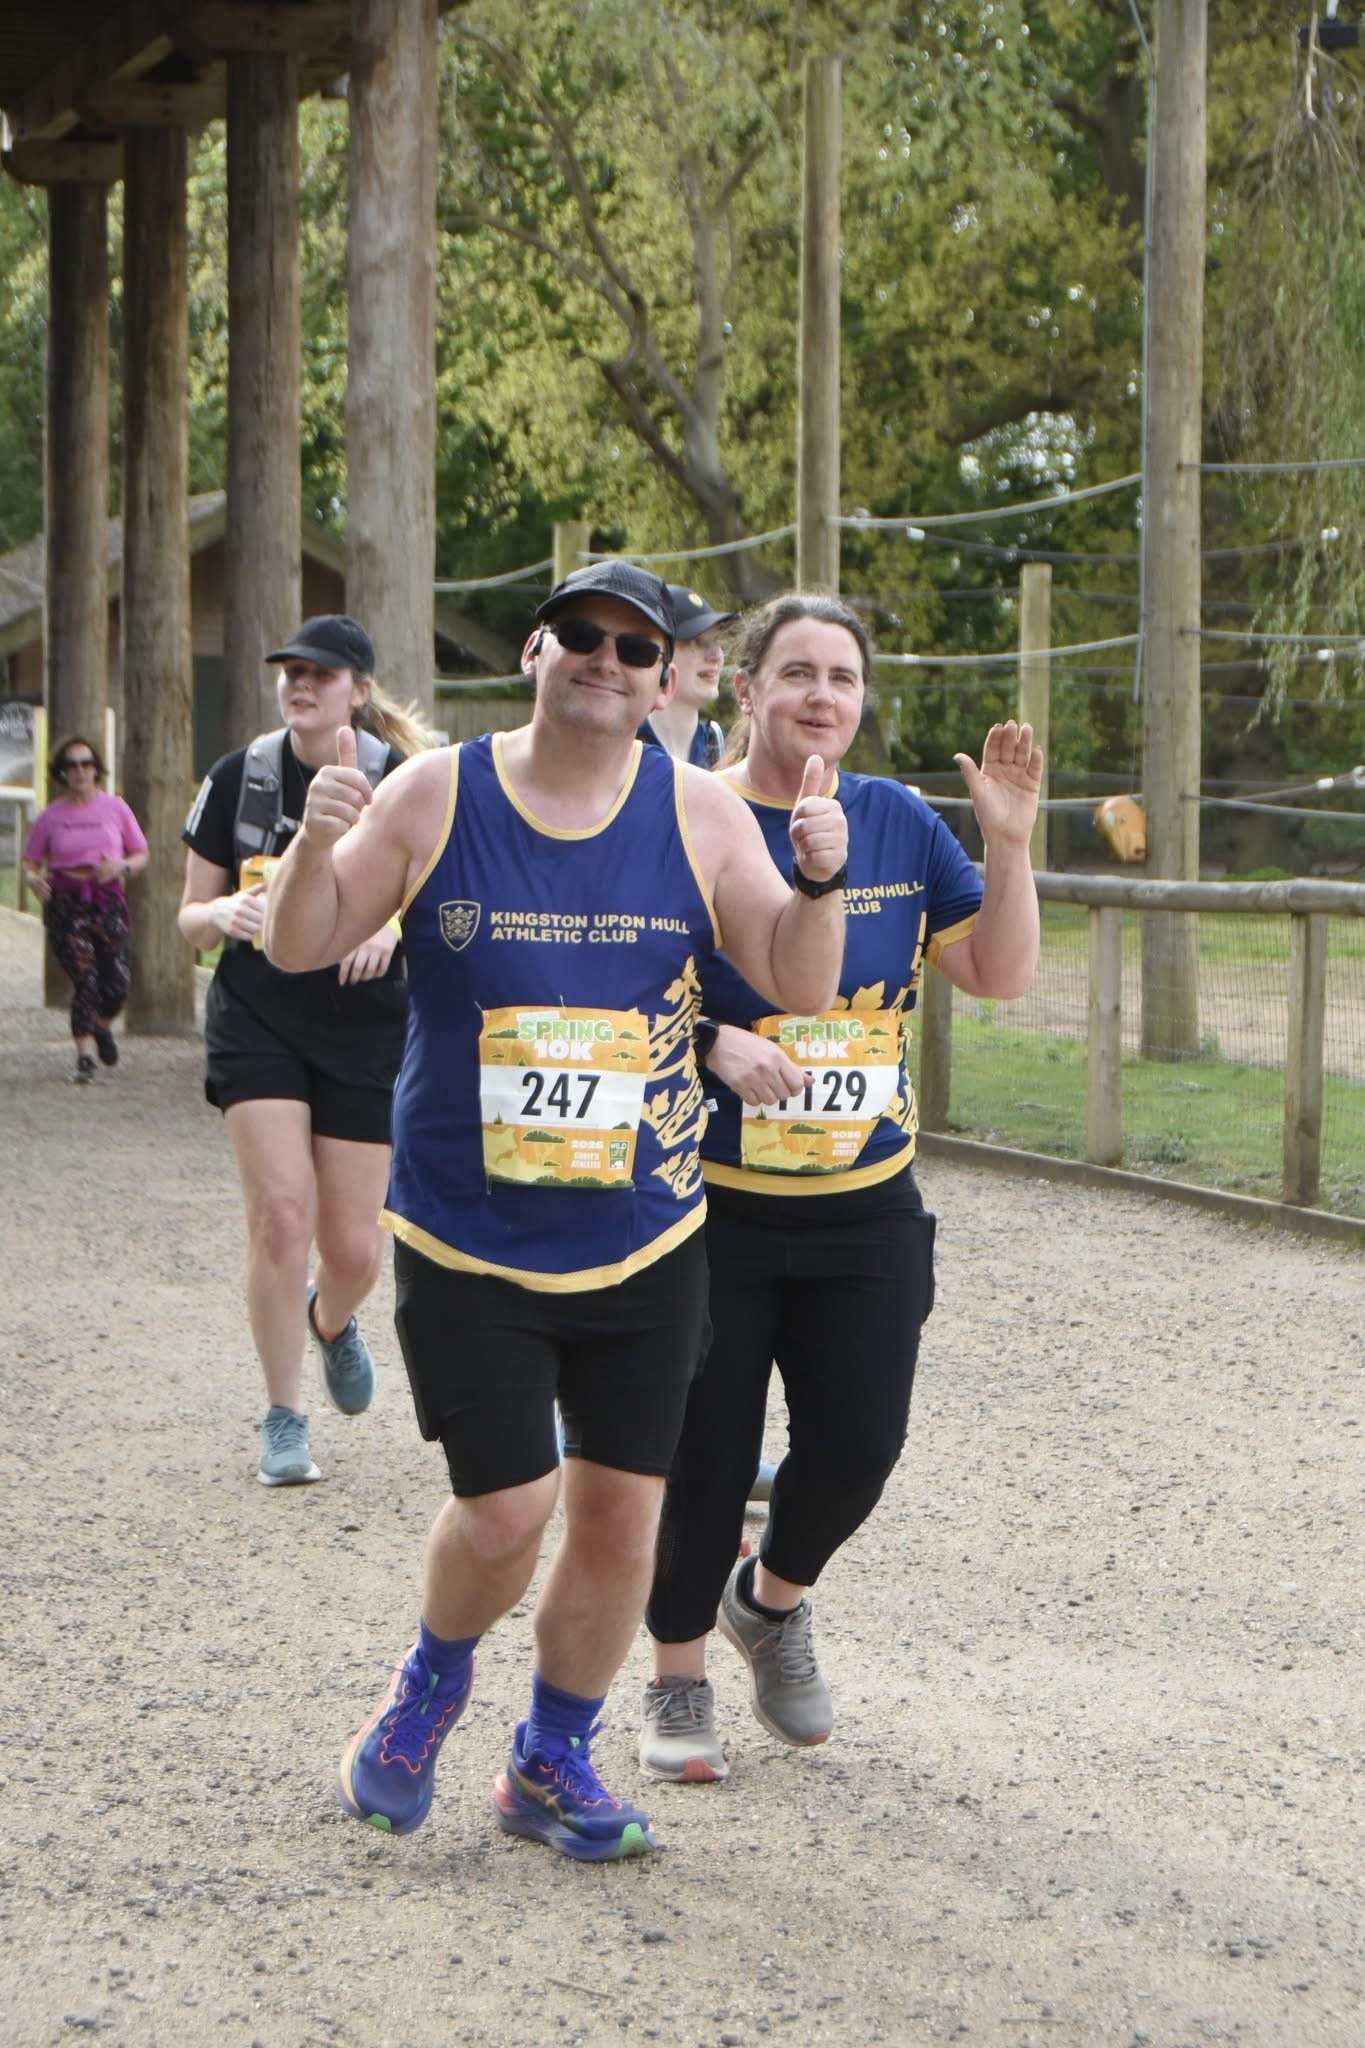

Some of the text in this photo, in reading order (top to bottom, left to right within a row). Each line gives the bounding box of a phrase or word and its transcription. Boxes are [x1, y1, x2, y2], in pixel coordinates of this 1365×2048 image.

[490, 911, 691, 934] KINGSTON UPON HULL
[491, 927, 638, 944] ATHLETIC CLUB
[518, 1019, 615, 1043] SPRING
[780, 1019, 866, 1045] SPRING
[534, 1040, 595, 1060] 10K
[794, 1040, 849, 1059] 10K
[520, 1071, 602, 1118] 247
[778, 1070, 867, 1111] 129
